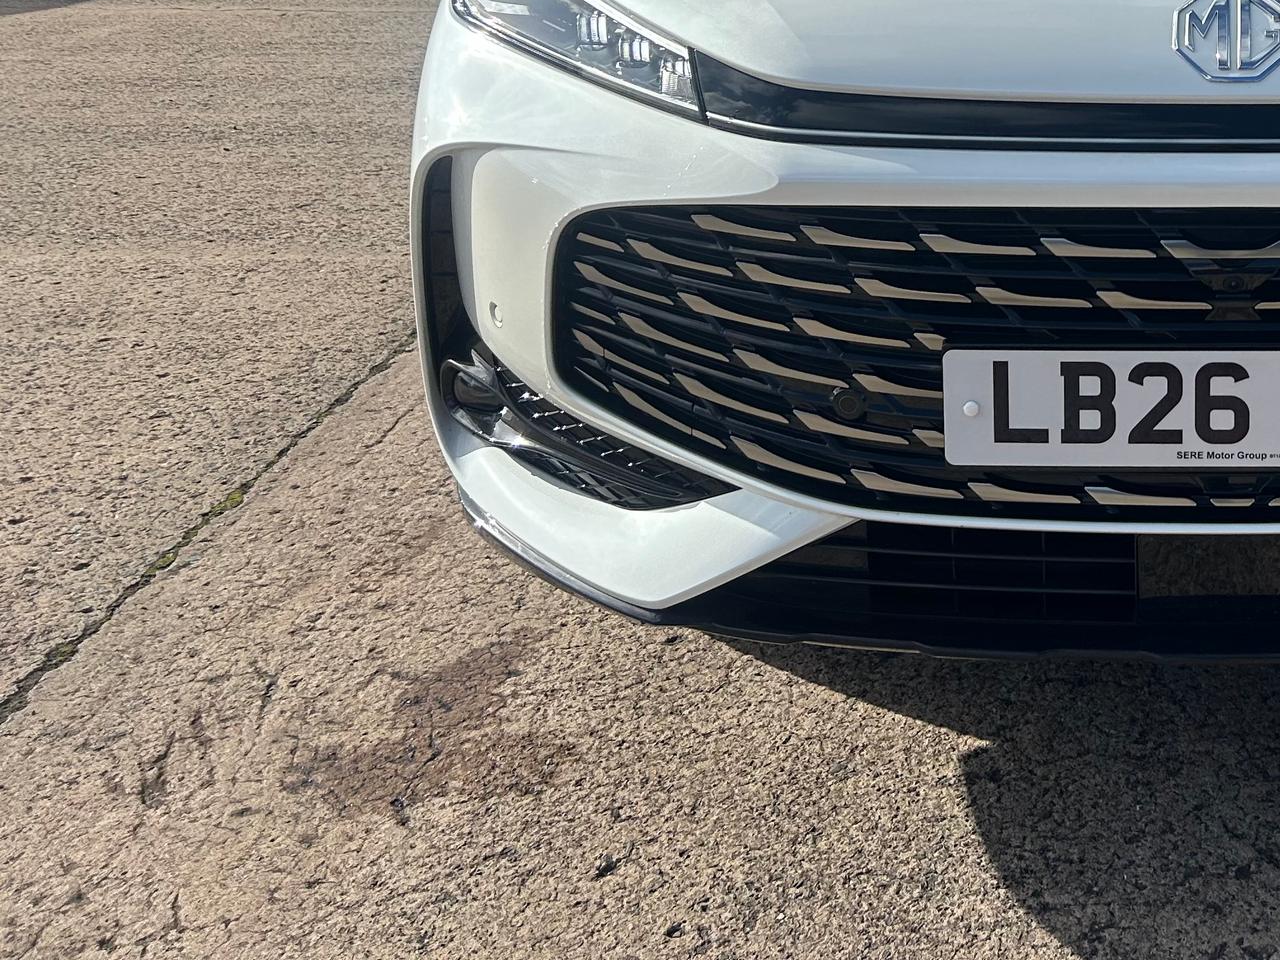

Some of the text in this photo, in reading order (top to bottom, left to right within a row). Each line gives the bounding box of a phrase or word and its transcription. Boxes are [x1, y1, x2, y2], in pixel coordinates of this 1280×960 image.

[992, 361, 1250, 444] LB26
[1176, 451, 1204, 459] SERE
[1206, 451, 1234, 459] Motor
[1237, 451, 1267, 461] Group
